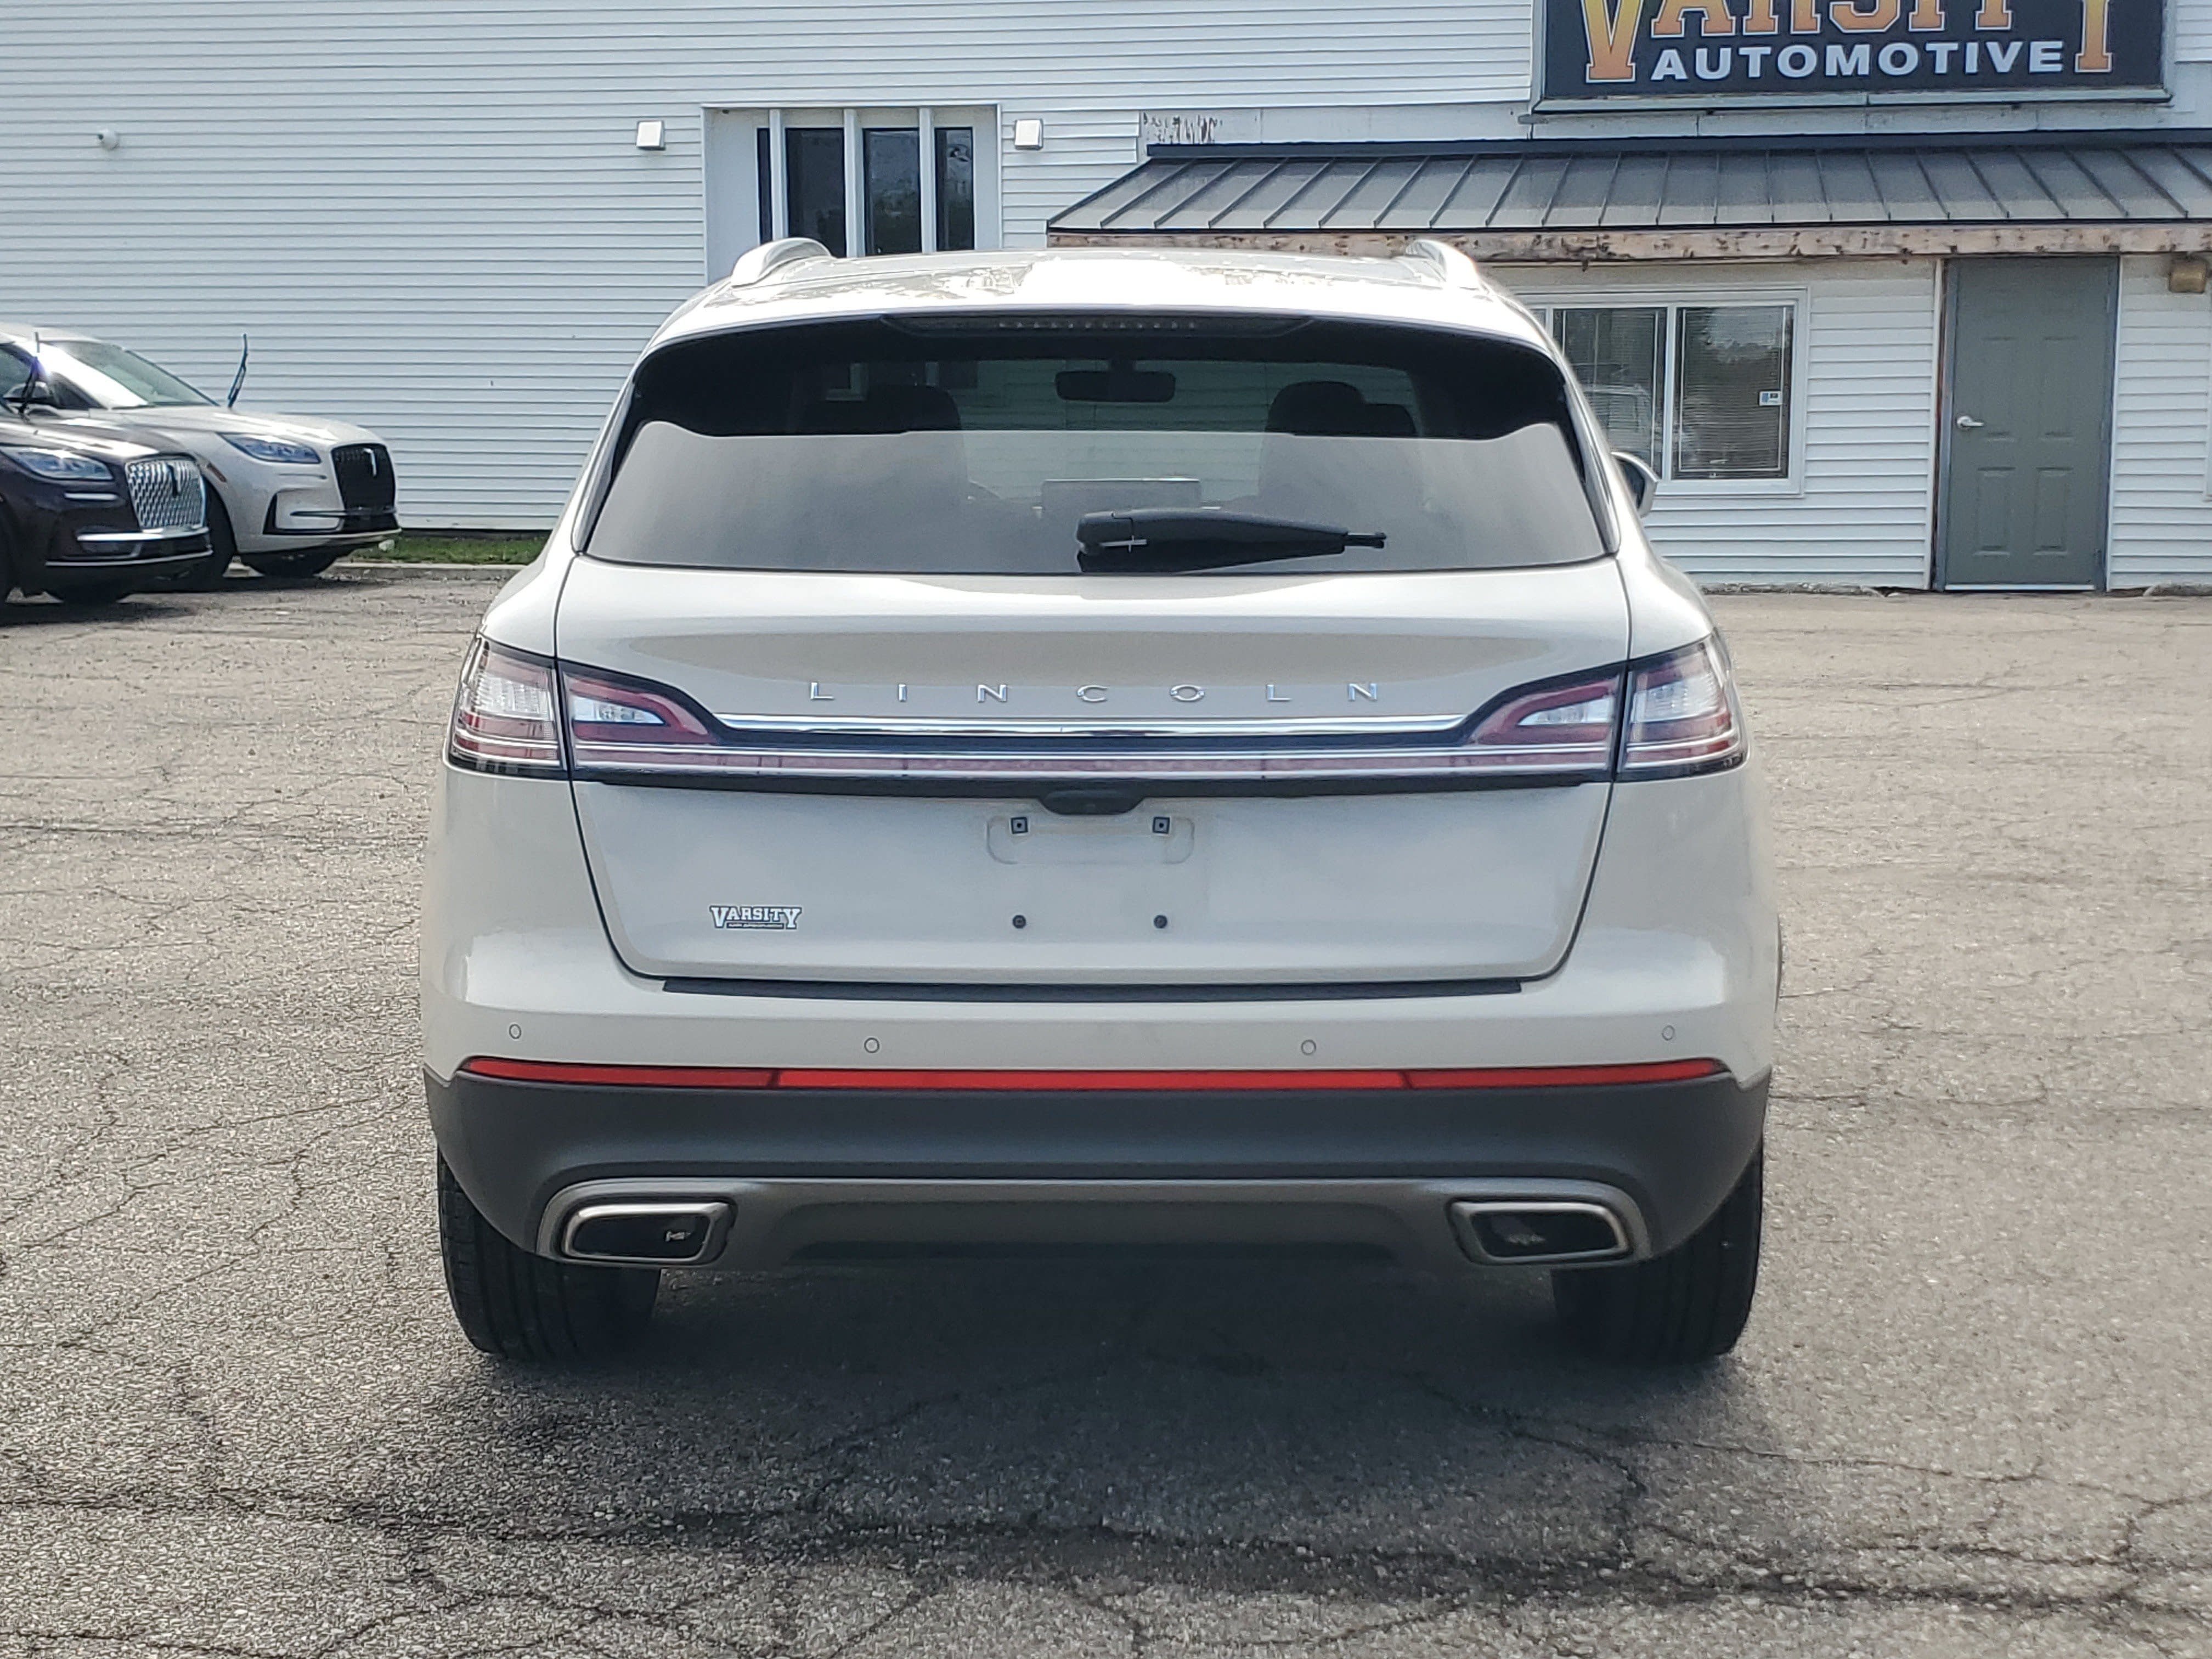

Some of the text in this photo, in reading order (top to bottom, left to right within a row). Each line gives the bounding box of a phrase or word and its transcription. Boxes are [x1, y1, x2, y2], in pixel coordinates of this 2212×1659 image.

[1650, 41, 2064, 81] AUTOMOTIVE
[810, 681, 1378, 703] LINCOLN
[710, 906, 801, 929] VARSITY
